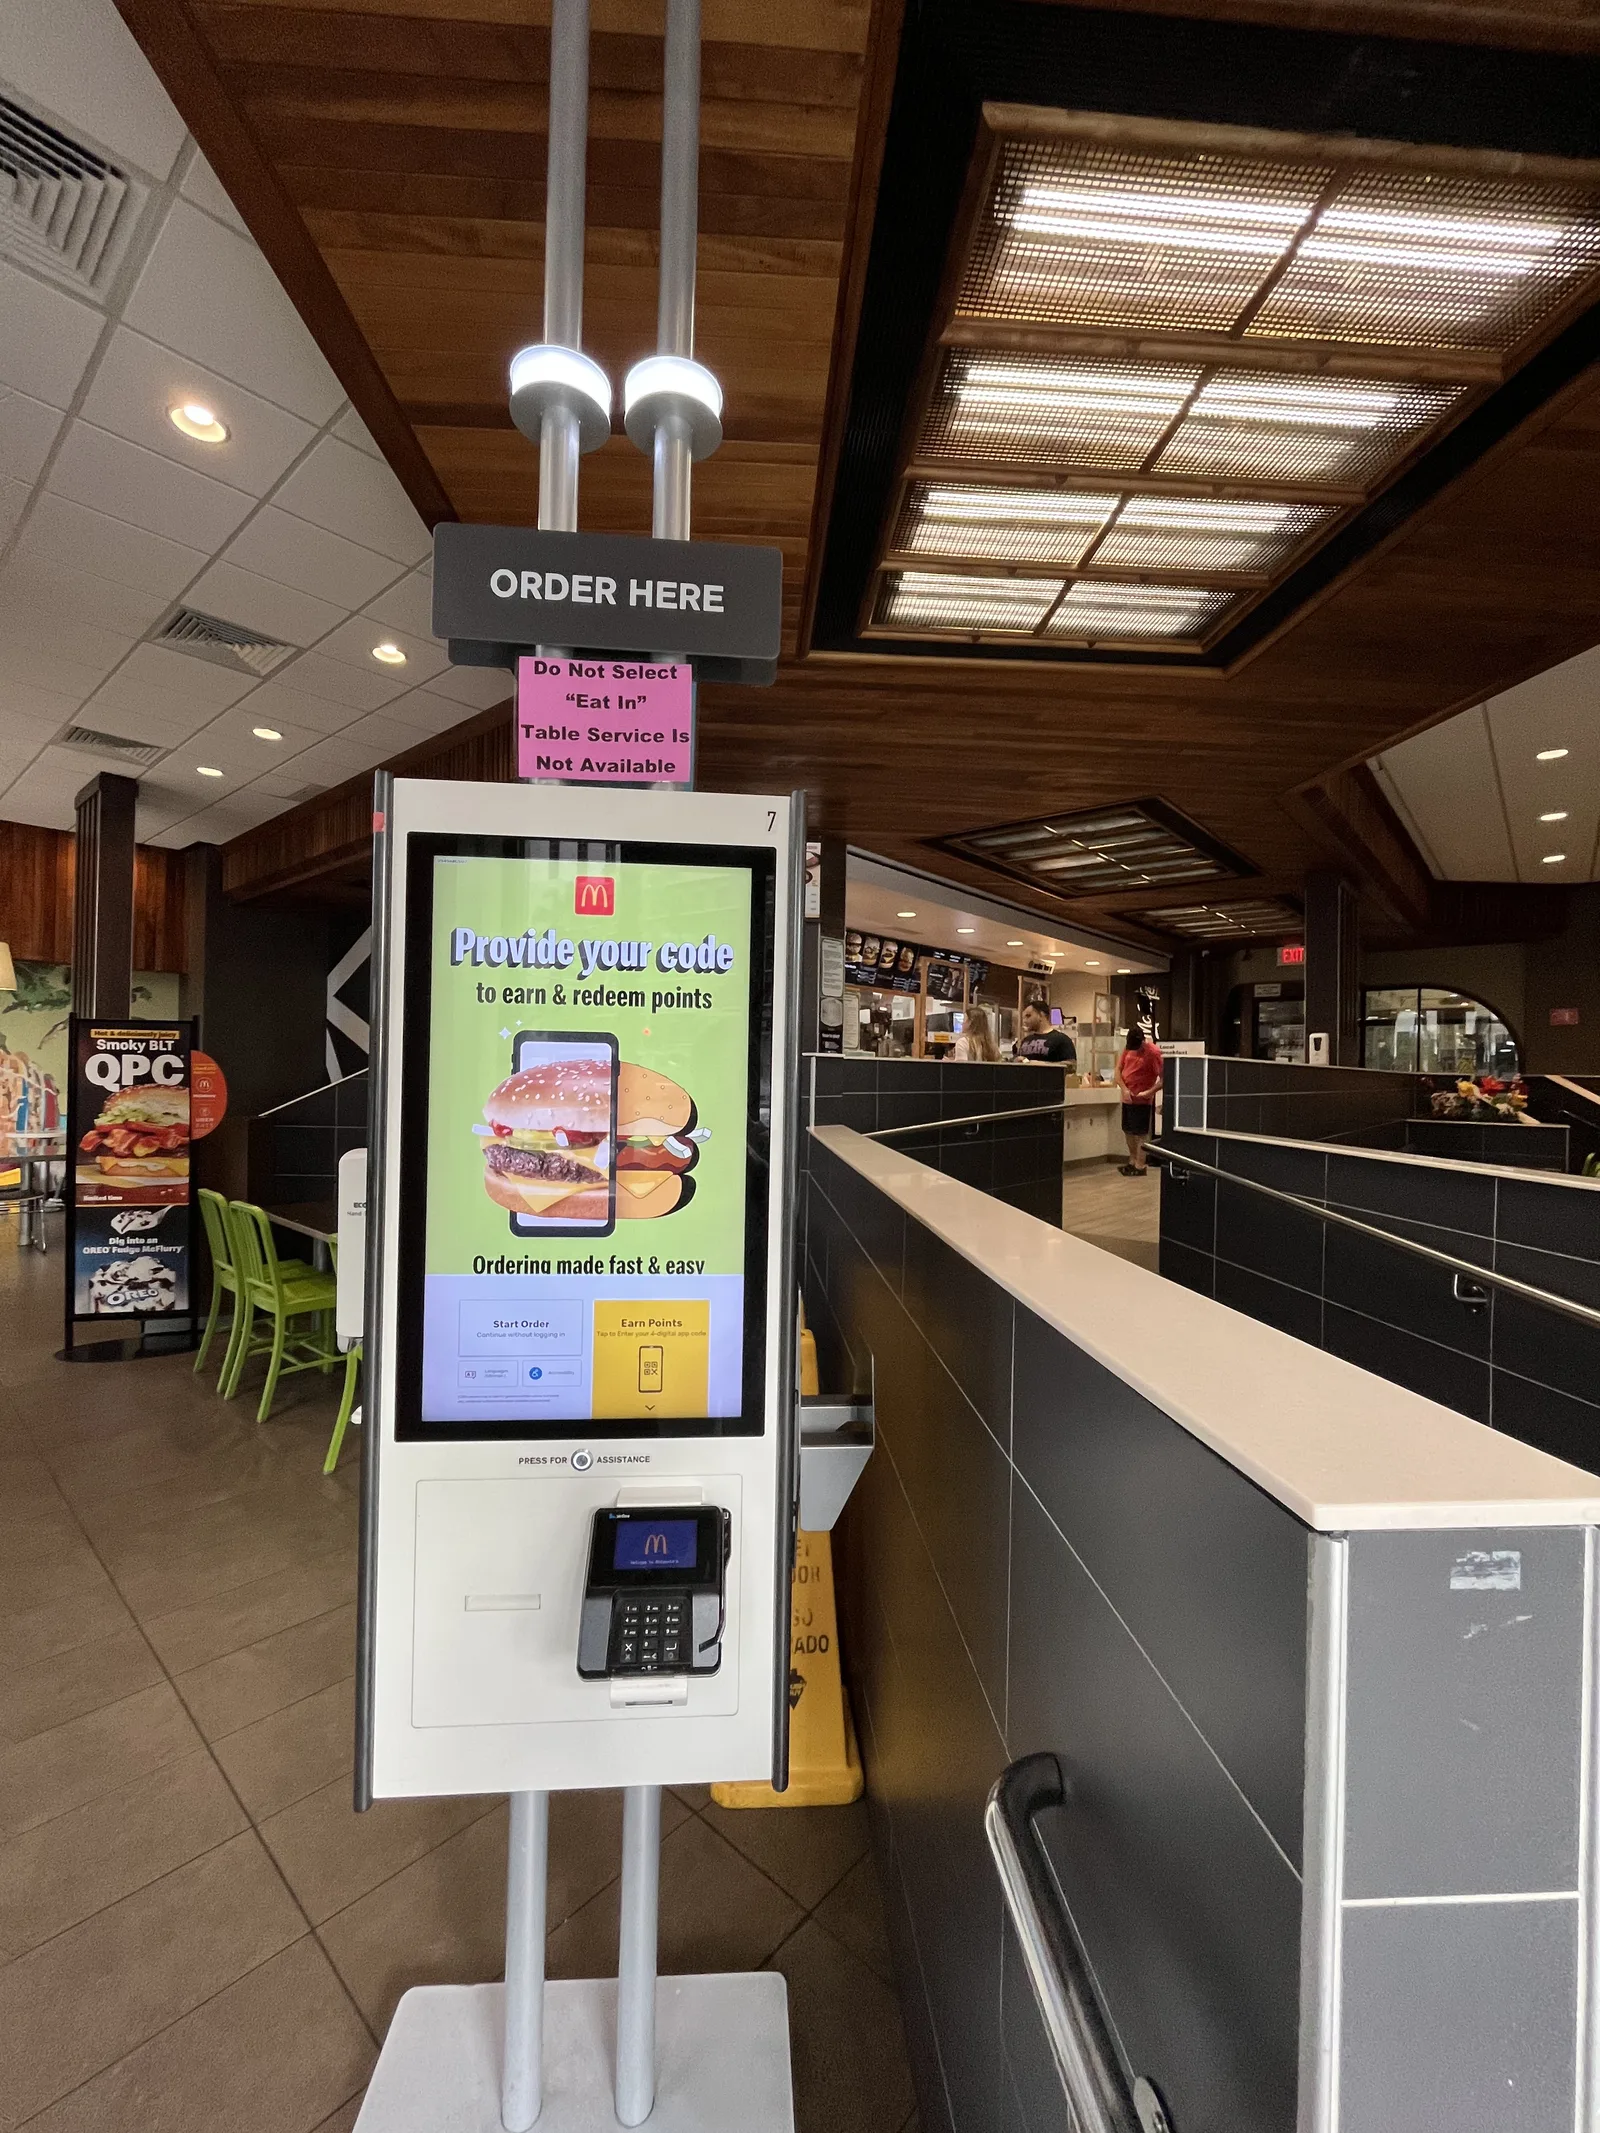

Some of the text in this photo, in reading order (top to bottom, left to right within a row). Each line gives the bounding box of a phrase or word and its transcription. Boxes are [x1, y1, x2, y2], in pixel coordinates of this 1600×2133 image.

[490, 568, 725, 613] ORDER HERE
[533, 660, 678, 680] Do Not Select
[566, 693, 647, 711] “Eat In”
[521, 724, 690, 743] Table Service Is
[536, 755, 676, 774] Not Available
[766, 811, 777, 833] 7
[451, 927, 735, 980] Provide your code
[1283, 947, 1304, 963] EXIT
[476, 982, 713, 1013] to earn & redeem points
[96, 1039, 175, 1053] Smoky BLT
[85, 1053, 184, 1093] QPC
[109, 1237, 125, 1246] Dig
[127, 1237, 145, 1245] into
[112, 1246, 140, 1255] Fudge
[556, 1256, 604, 1275] made
[609, 1255, 643, 1275] fast
[648, 1255, 661, 1274] &
[666, 1259, 706, 1275] easy
[107, 1289, 158, 1305] OREO
[493, 1320, 550, 1328] Start Order
[621, 1318, 683, 1327] Earn Points
[534, 1331, 558, 1339] logging
[518, 1455, 650, 1465] PRESS FOR ASSISTANCE
[795, 1634, 829, 1654] ADO
